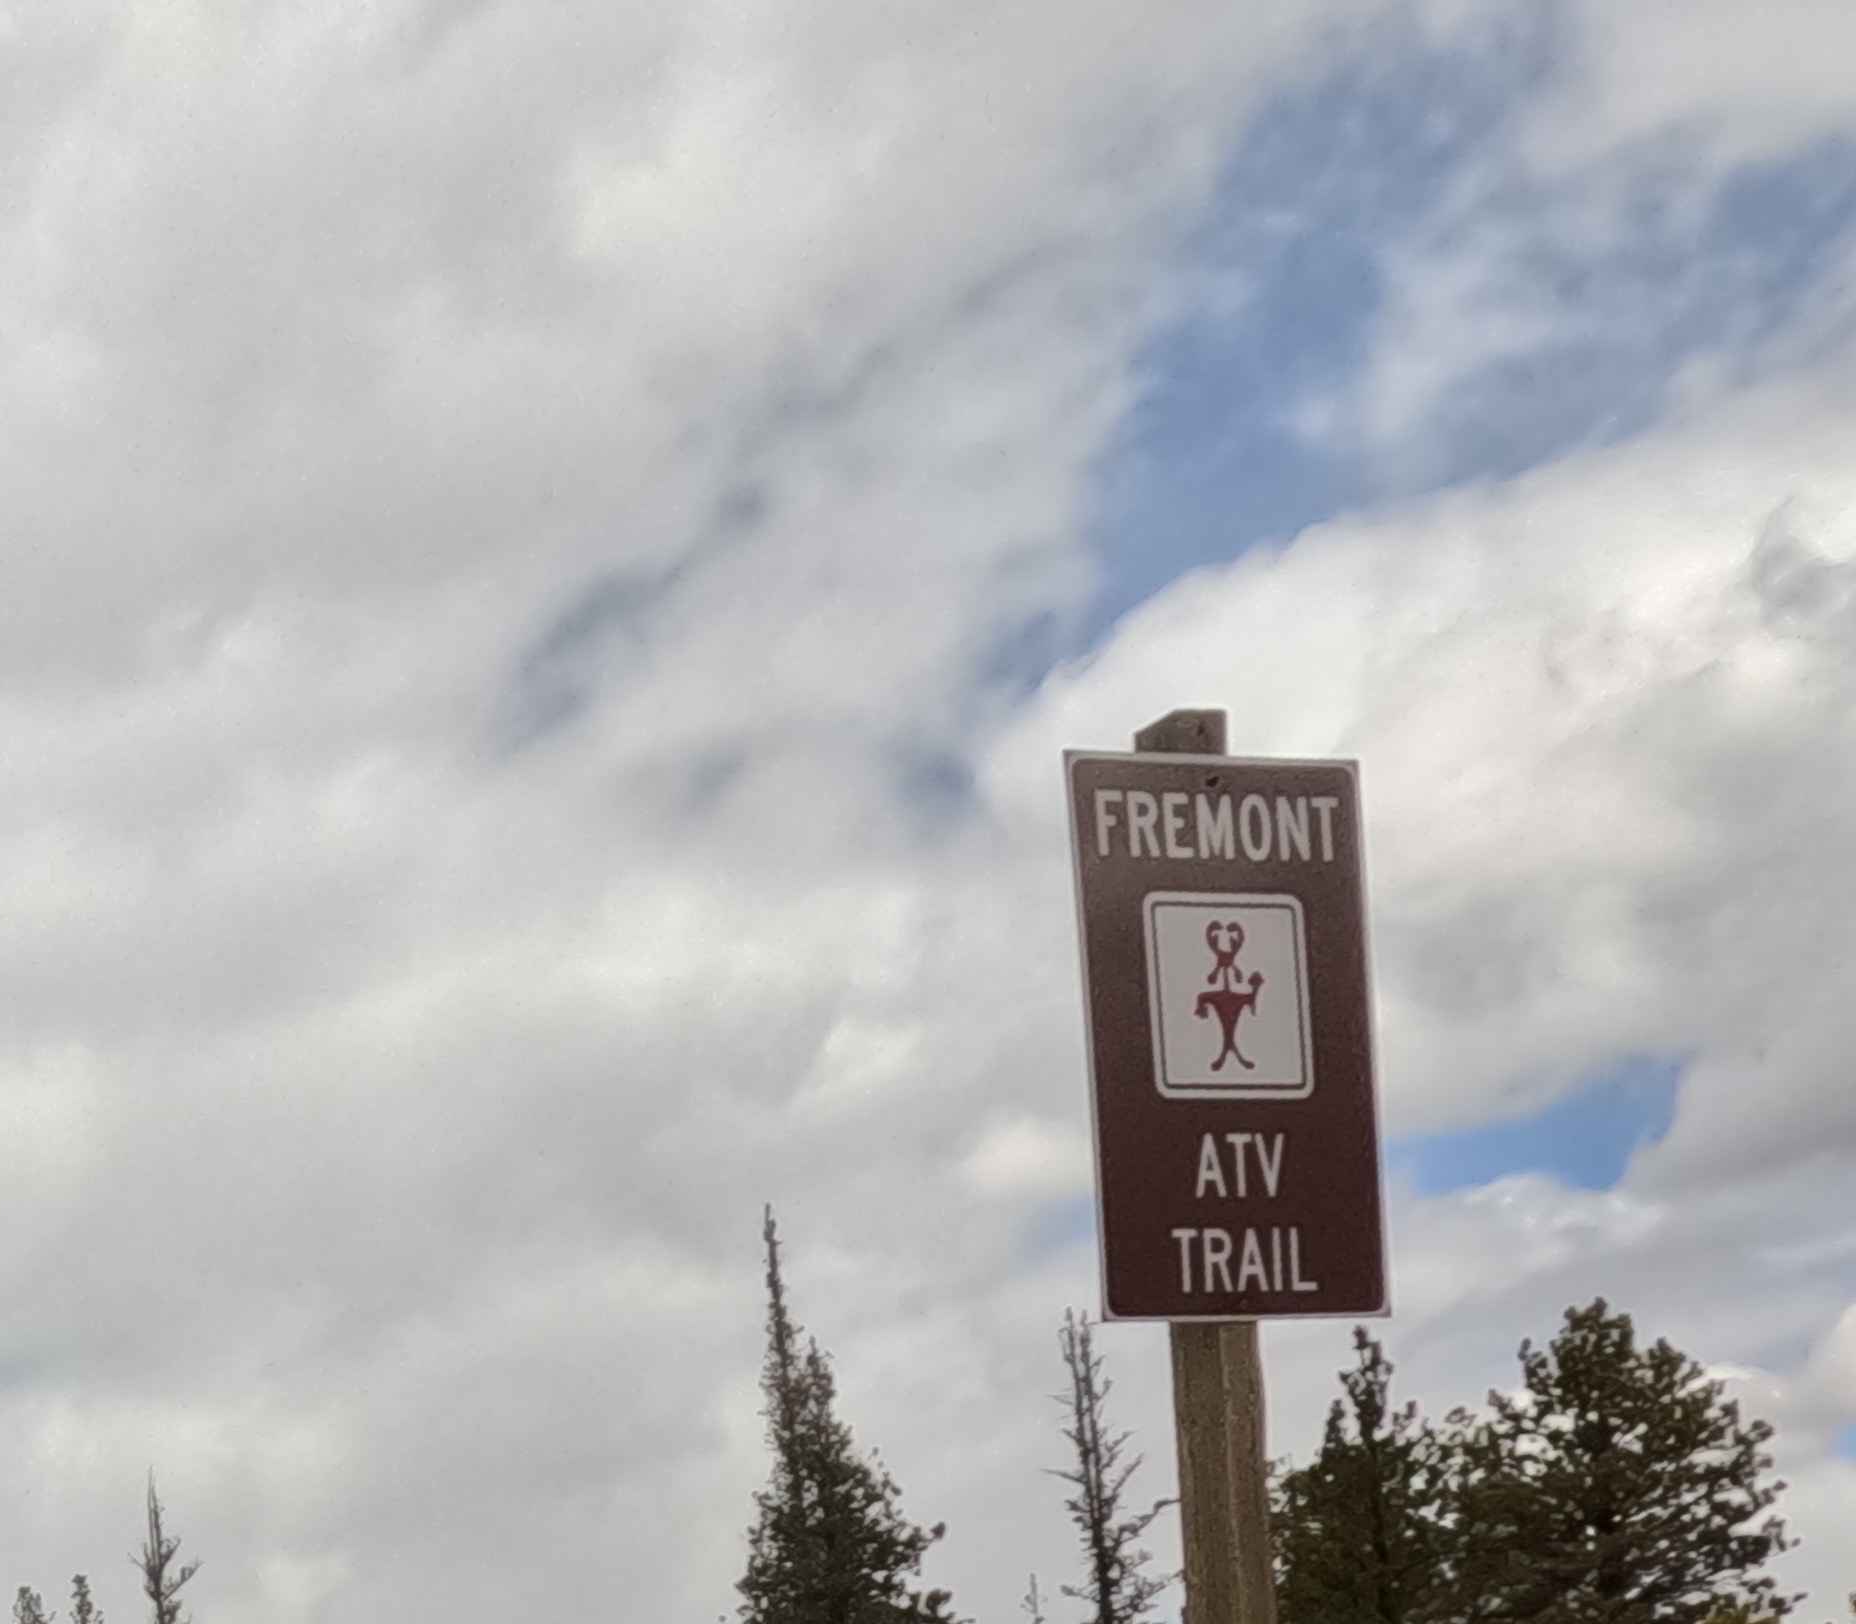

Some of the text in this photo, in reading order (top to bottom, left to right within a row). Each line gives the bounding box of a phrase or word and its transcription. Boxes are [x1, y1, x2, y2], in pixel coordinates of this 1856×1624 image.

[1092, 788, 1339, 863] FREMONT
[1195, 1132, 1285, 1199] ATV
[1171, 1227, 1319, 1292] TRAIL
